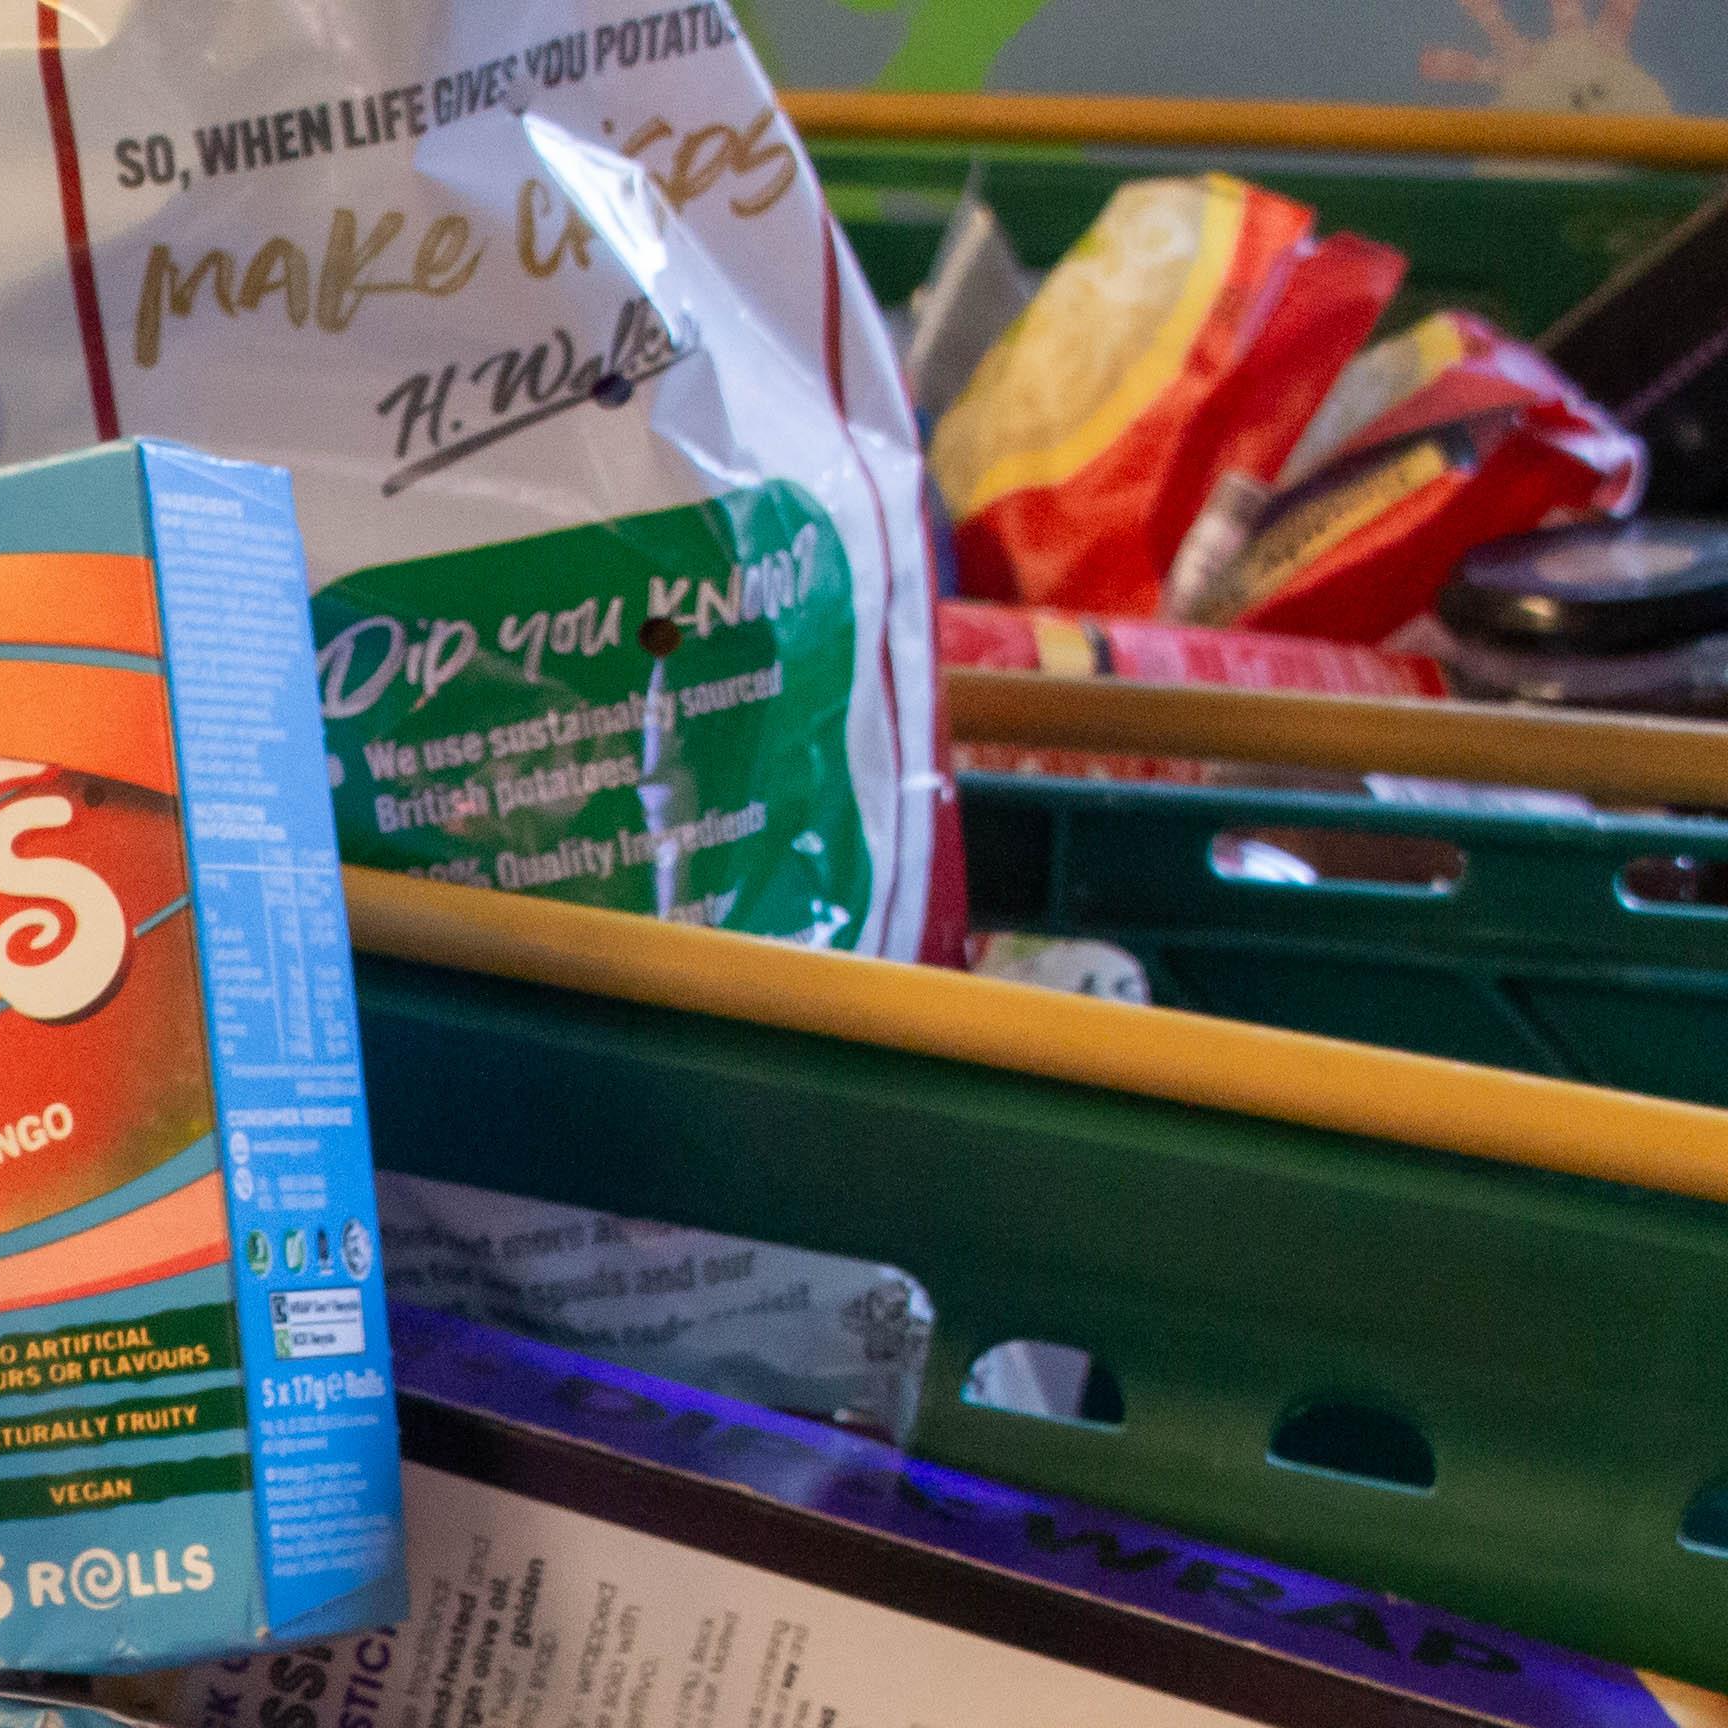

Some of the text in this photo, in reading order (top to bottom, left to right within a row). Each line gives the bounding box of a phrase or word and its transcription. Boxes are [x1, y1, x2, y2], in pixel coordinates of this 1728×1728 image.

[115, 134, 192, 191] SO,
[196, 108, 333, 178] WHEN
[342, 88, 428, 150] LIFE
[364, 661, 784, 780] We use sustainably sourced
[375, 779, 489, 834] British
[496, 838, 615, 891] Quality
[24, 1327, 154, 1365] ARTIFICIAL
[52, 1362, 87, 1386] OR
[92, 1345, 211, 1383] FLAVOURS
[119, 1406, 199, 1437] FRUITY
[49, 1479, 133, 1506] VEGAN
[1020, 1506, 1522, 1677] WRAP
